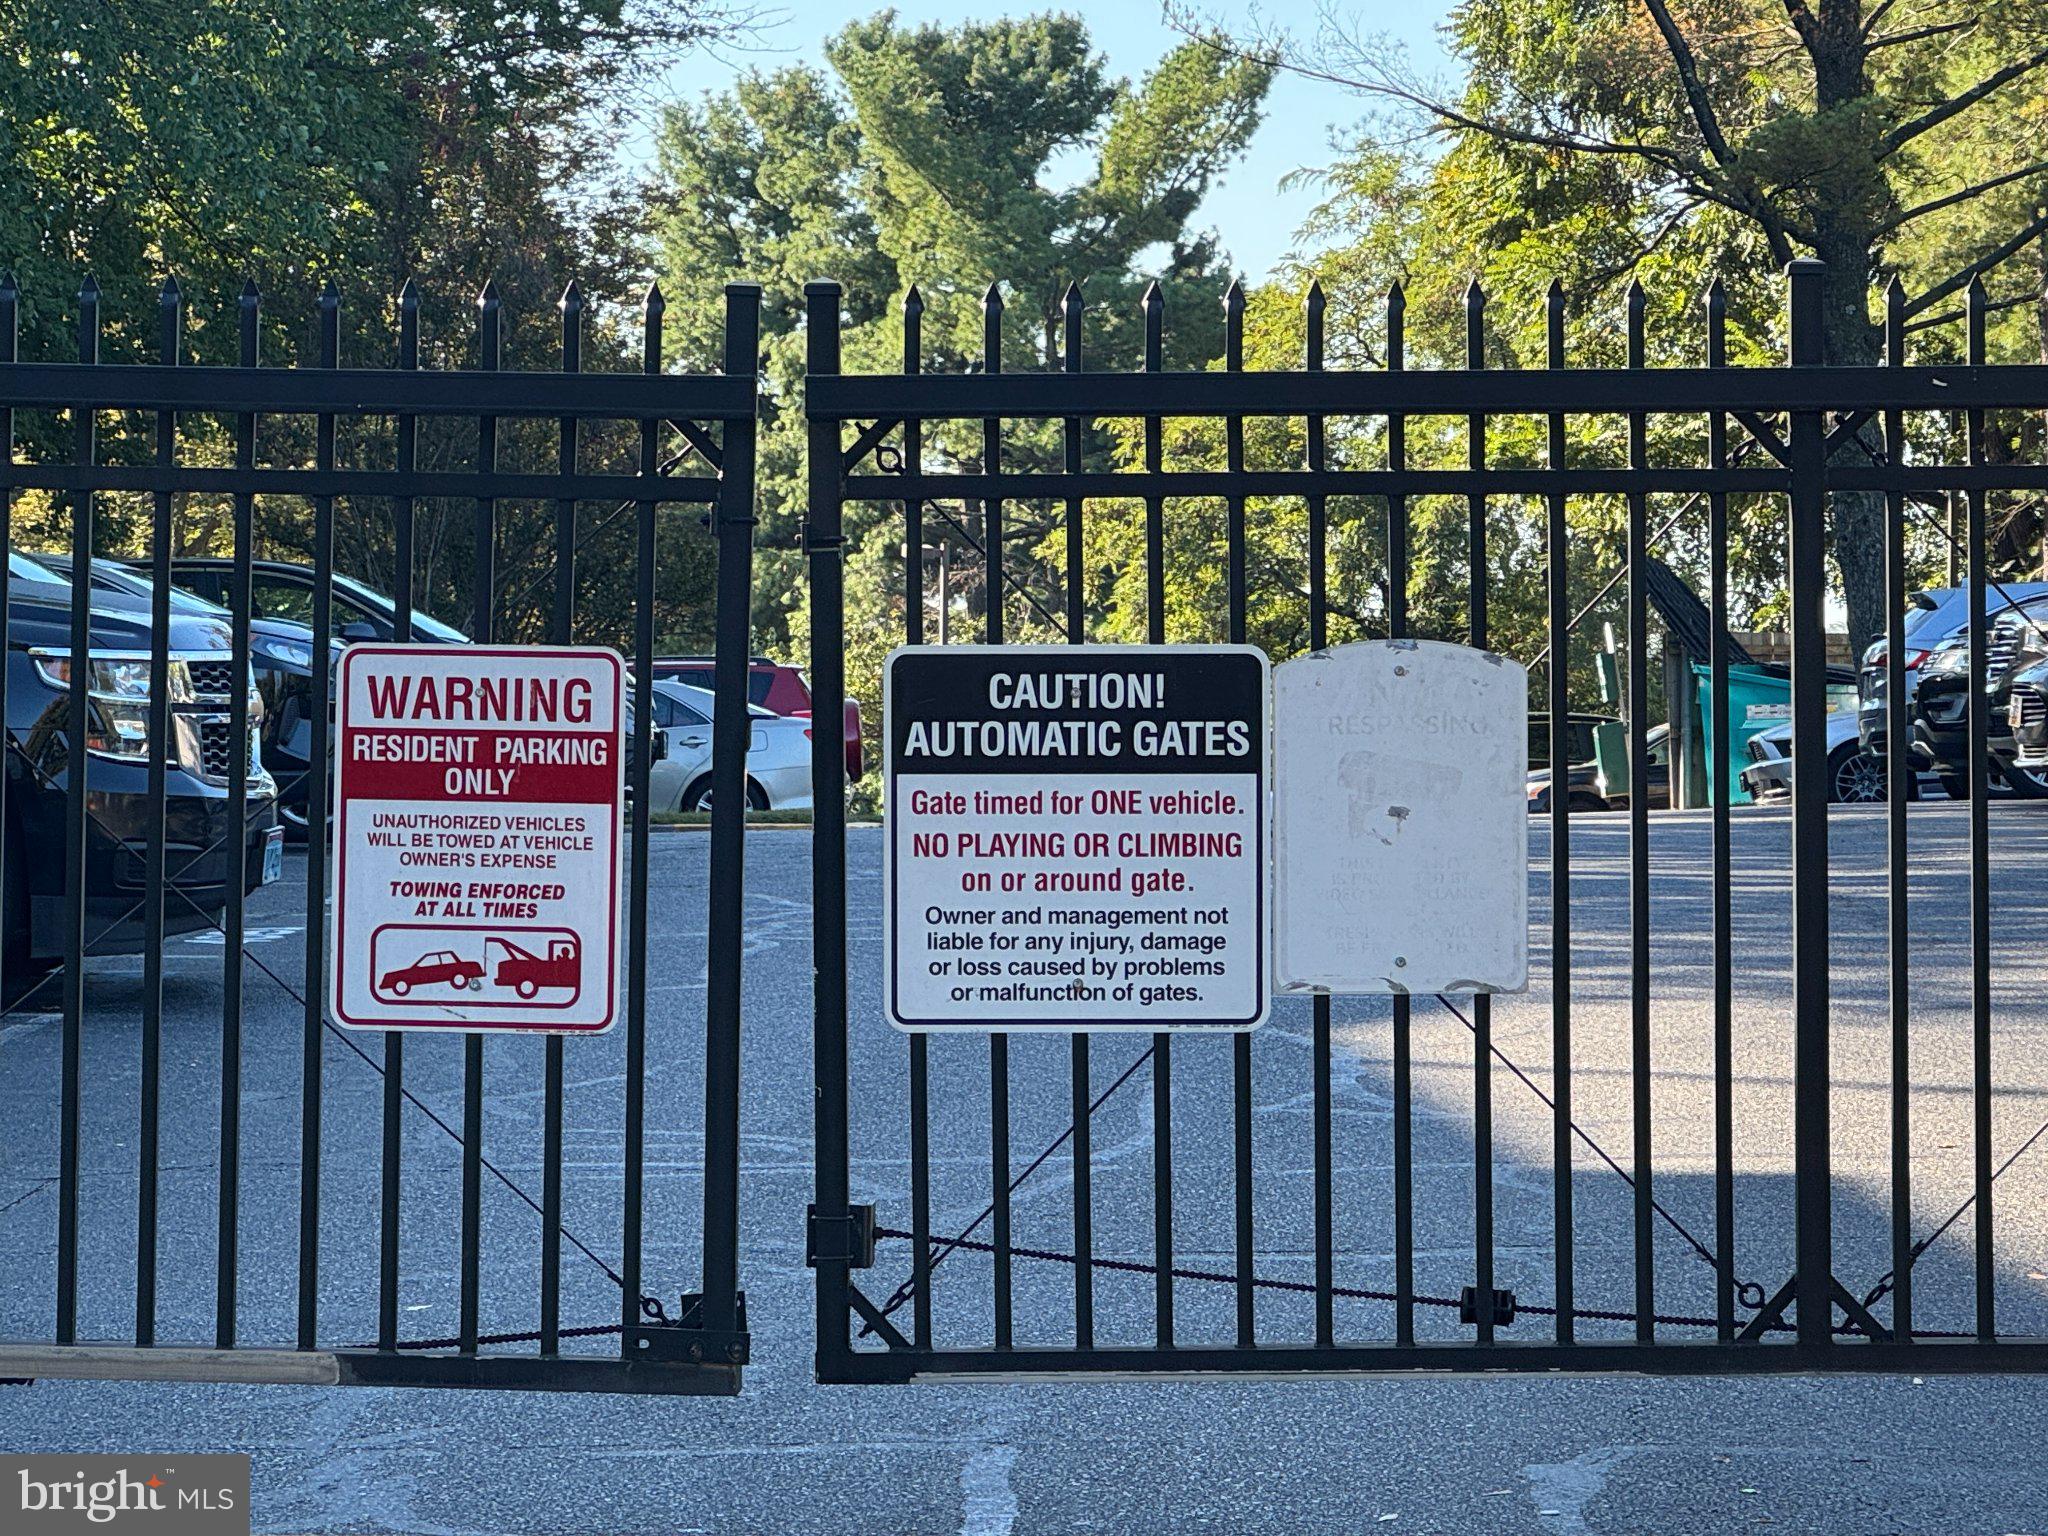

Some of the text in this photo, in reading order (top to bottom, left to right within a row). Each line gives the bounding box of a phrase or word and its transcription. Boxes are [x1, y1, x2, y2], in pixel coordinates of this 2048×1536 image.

[367, 675, 592, 723] WARNING
[989, 673, 1165, 710] CAUTION!
[352, 735, 607, 766] RESIDENT PARKING
[904, 721, 1250, 757] AUTOMATIC GATES
[445, 769, 515, 795] ONLY
[911, 790, 1245, 815] Gate timed for ONE vehicle.
[372, 813, 586, 832] UNAUTHORIZED VEHICLES
[367, 833, 594, 851] WILL BE TOWED AT VEHICLE
[913, 833, 1243, 858] NO PLAYING OR CLIMBING
[399, 853, 557, 869] OWNER'S EXPENSE
[389, 881, 566, 901] TOWING ENFORCED
[961, 868, 1195, 897] on or around gate.
[414, 901, 538, 919] AT ALL TIMES
[925, 906, 1229, 929] Owner and management not
[927, 932, 1227, 955] liable for any injury, damage
[928, 958, 1226, 981] or loss caused by problems
[950, 984, 1204, 1005] or malfunction of gates.
